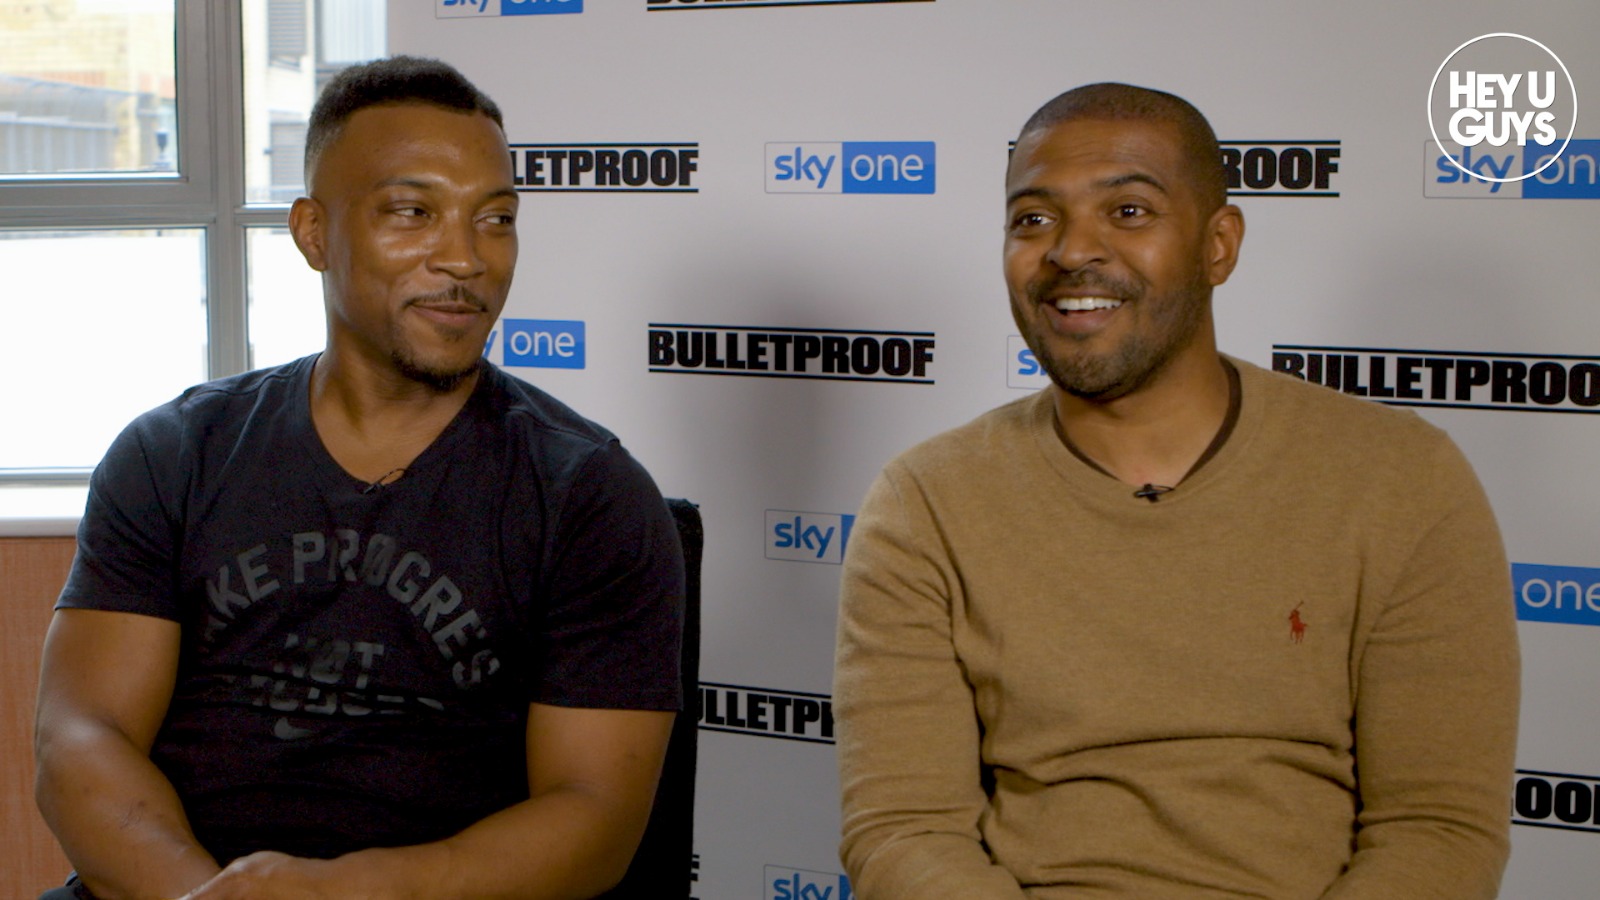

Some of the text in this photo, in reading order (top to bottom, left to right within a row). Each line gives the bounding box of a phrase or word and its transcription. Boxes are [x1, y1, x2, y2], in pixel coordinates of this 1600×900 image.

[510, 149, 699, 187] LETPROOF
[775, 147, 924, 189] sky one
[1219, 147, 1341, 189] ROOF
[1436, 146, 1600, 194] sky on
[510, 330, 575, 357] one
[648, 329, 935, 377] BULLETPROOF
[774, 515, 835, 558] sky
